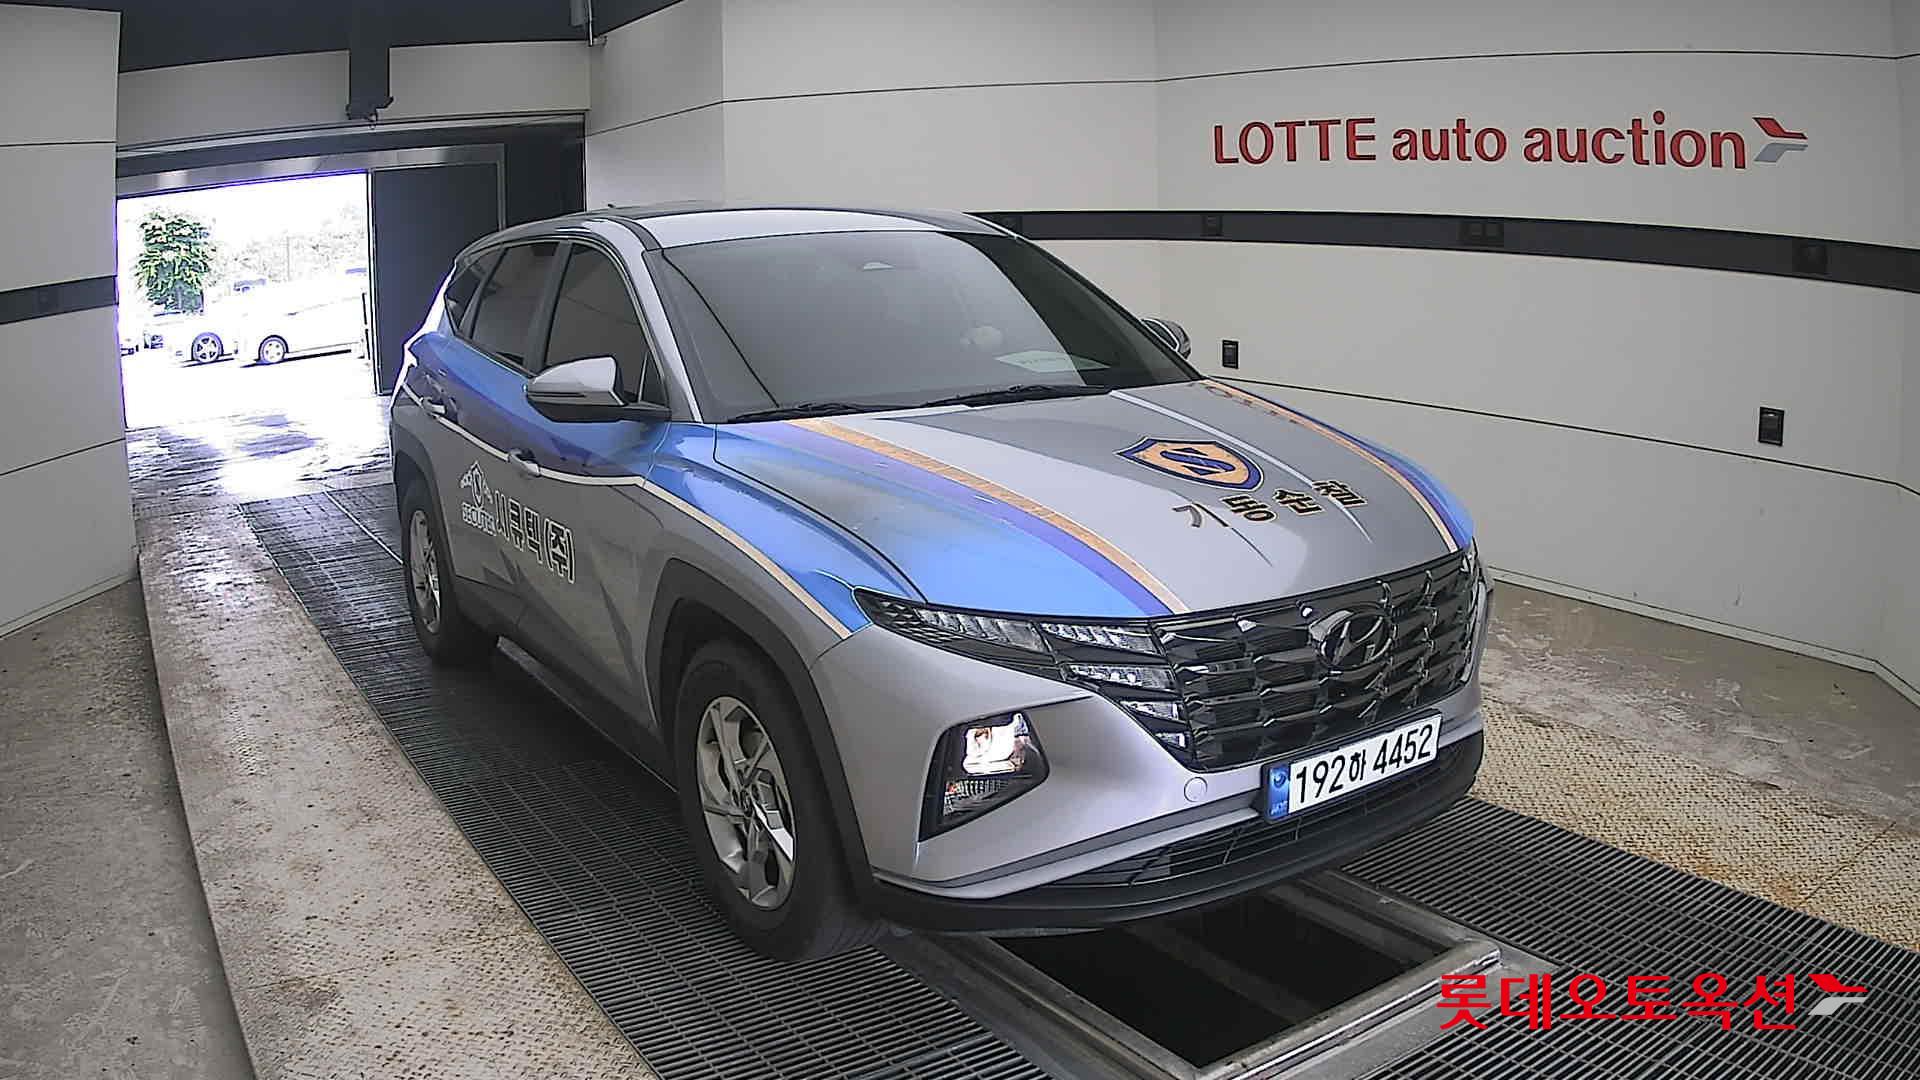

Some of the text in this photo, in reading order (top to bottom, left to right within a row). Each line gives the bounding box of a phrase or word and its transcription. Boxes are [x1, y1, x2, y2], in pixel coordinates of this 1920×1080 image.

[1213, 110, 1748, 170] LOTTE auto auction
[1296, 724, 1433, 803] 192하 4452
